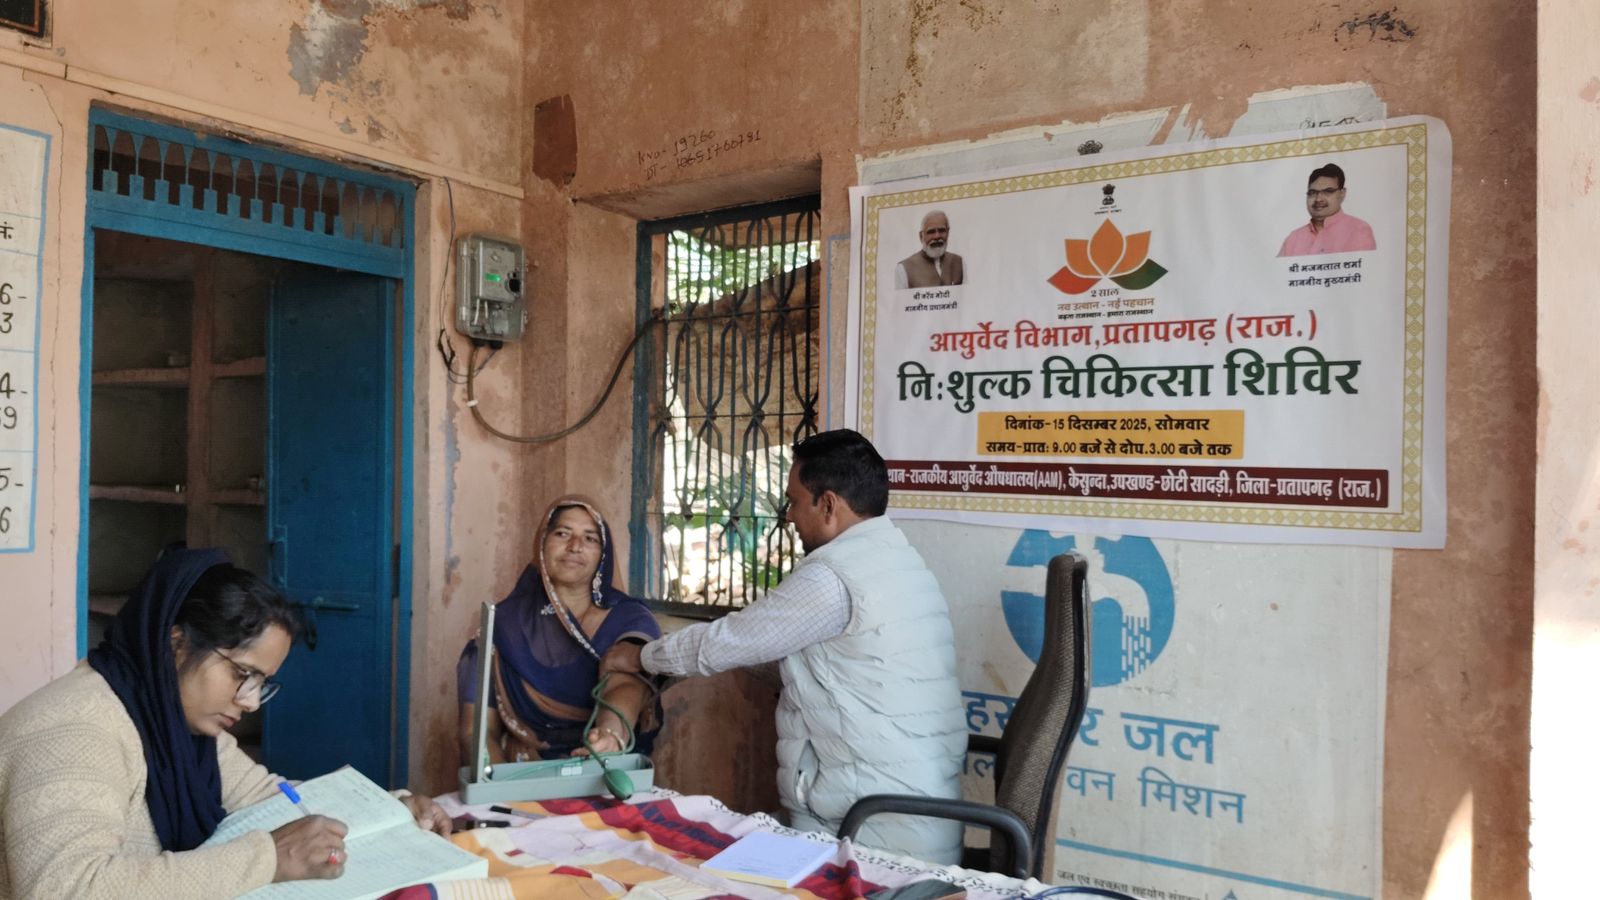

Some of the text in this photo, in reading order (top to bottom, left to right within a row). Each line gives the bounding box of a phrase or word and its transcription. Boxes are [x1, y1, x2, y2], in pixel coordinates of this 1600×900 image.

[1301, 262, 1341, 272] भजनलाल
[1343, 258, 1362, 269] शर्मा
[1288, 273, 1361, 288] माननीय मुख्यमंत्री
[1099, 288, 1119, 297] साल
[929, 322, 1009, 360] आयुर्वेद
[1225, 310, 1318, 343] (राज.)
[897, 346, 1361, 413] नि:शुल्क चिकित्सा शिविर
[1005, 415, 1209, 433] दिनांक-15 दिसम्बर 2025, सोमवार
[1052, 441, 1077, 454] 9.00
[1079, 439, 1102, 454] बजे
[1104, 439, 1116, 454] से
[1178, 439, 1203, 456] बजे
[1206, 443, 1232, 456] तक
[887, 464, 947, 484] थान-राजकीय
[948, 464, 983, 491] आयुर्वेद
[1338, 477, 1382, 502] (राज.)
[1120, 712, 1220, 764] जल
[1137, 766, 1247, 824] मिशन
[1057, 869, 1075, 882] जल
